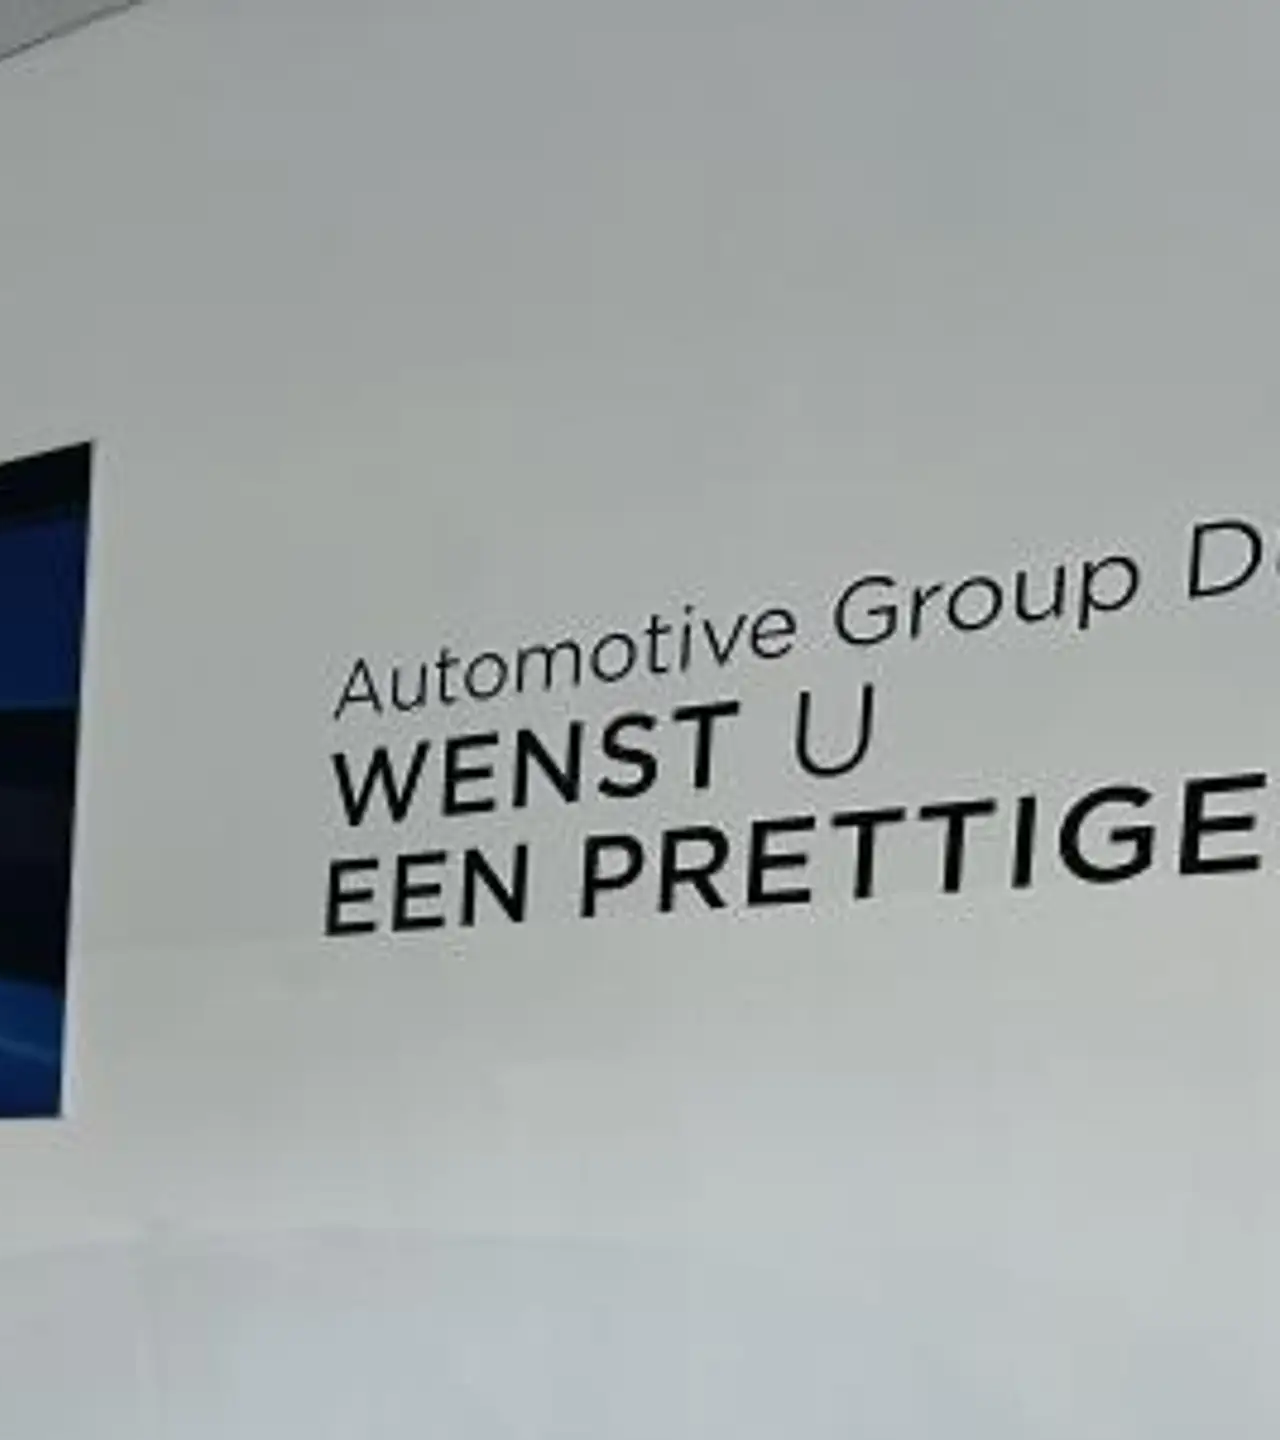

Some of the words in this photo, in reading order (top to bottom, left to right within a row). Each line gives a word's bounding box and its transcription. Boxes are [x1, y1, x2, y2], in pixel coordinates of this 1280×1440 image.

[333, 605, 797, 721] Automotive
[833, 556, 1141, 647] Group
[1188, 519, 1280, 601] D
[330, 699, 742, 828] WENST
[794, 682, 875, 779] U
[324, 843, 530, 938] EEN
[580, 772, 1268, 919] PRETTIGE
